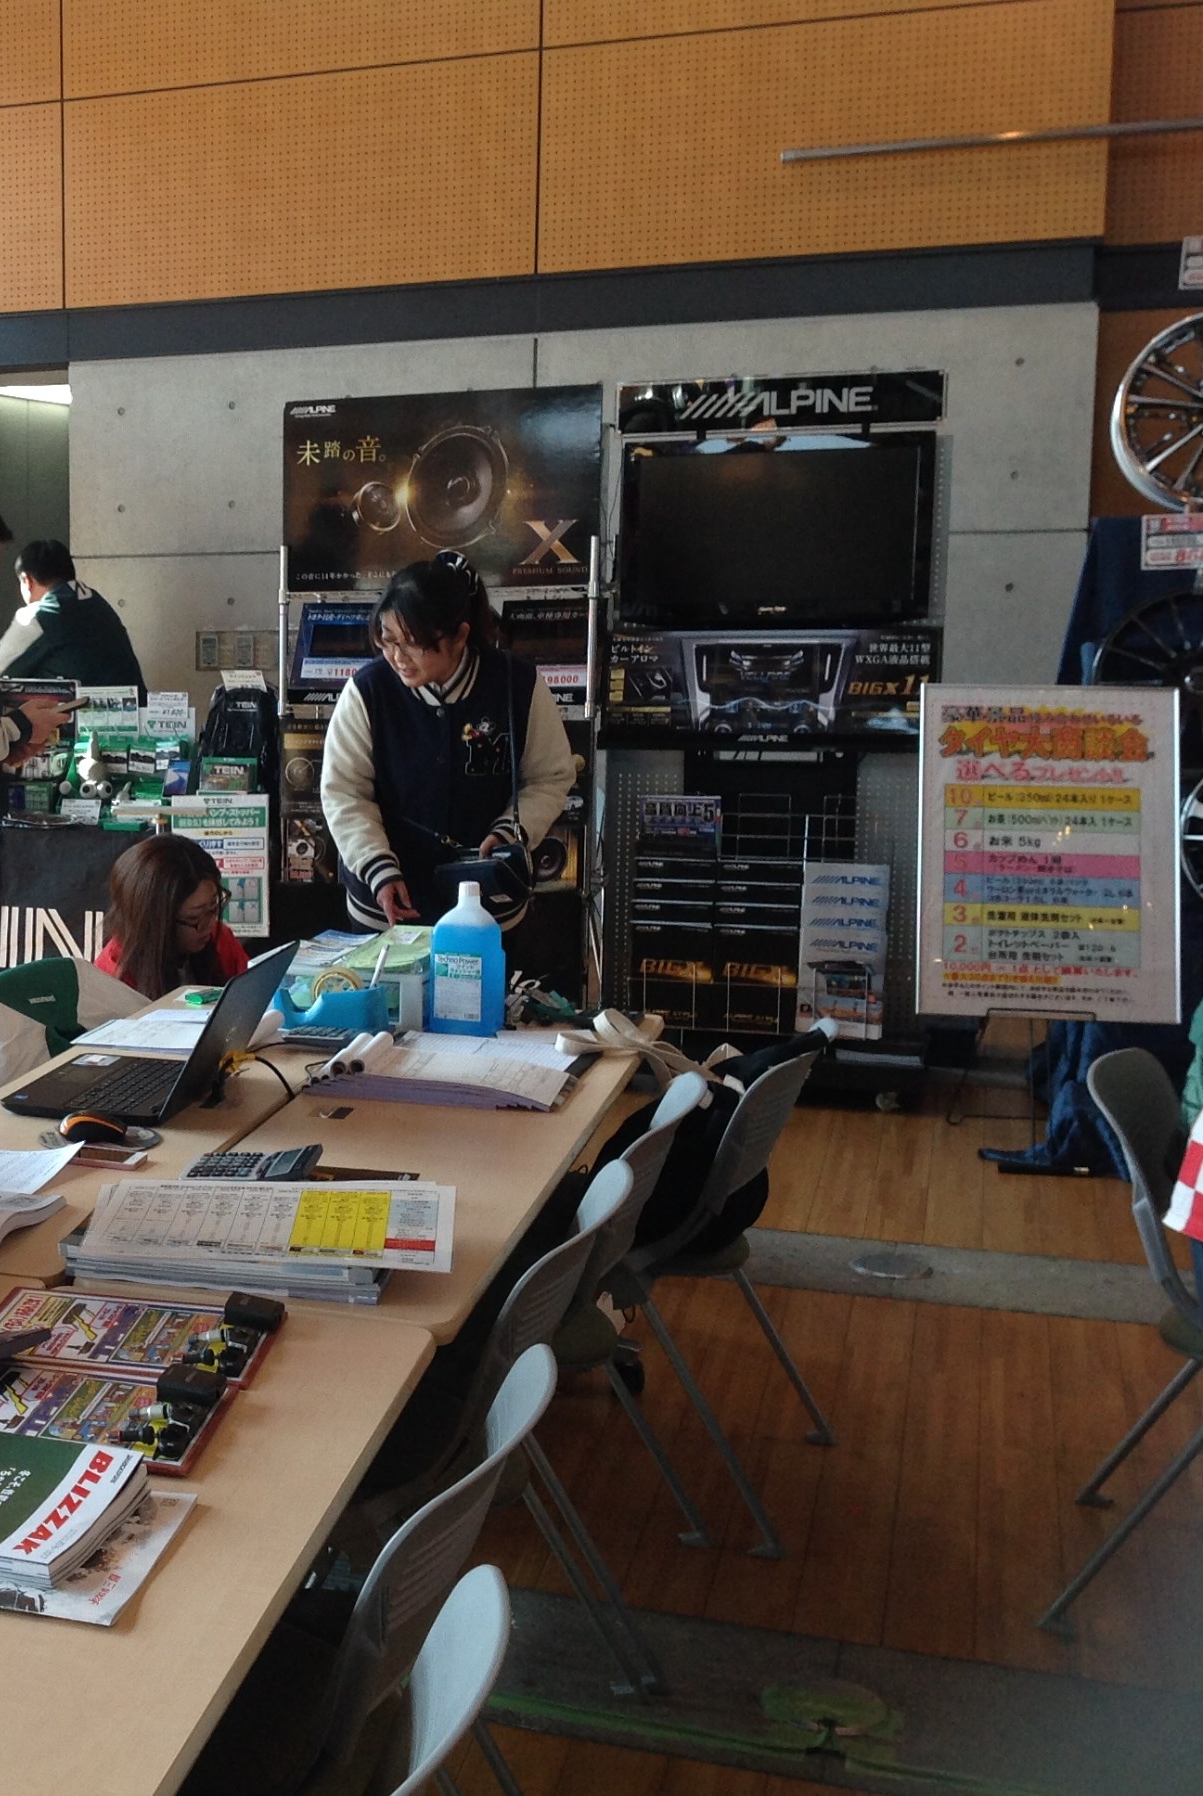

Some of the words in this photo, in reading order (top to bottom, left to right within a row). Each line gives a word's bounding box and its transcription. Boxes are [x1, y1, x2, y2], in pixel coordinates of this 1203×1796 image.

[741, 386, 873, 416] ALPINE
[304, 405, 336, 414] ALPINE
[519, 519, 580, 565] X
[158, 720, 187, 729] TEIN
[213, 765, 245, 775] TEIN
[949, 788, 973, 804] 10
[954, 809, 969, 826] 7
[954, 831, 969, 849] 6
[834, 875, 880, 886] ALPINE
[953, 879, 968, 896] 4
[833, 897, 879, 908] ALPINE
[953, 905, 967, 923] 3
[831, 918, 878, 928] ALPINE
[831, 940, 879, 952] ALPINE
[953, 935, 967, 953] 2
[12, 1450, 114, 1555] BLIZZAK
